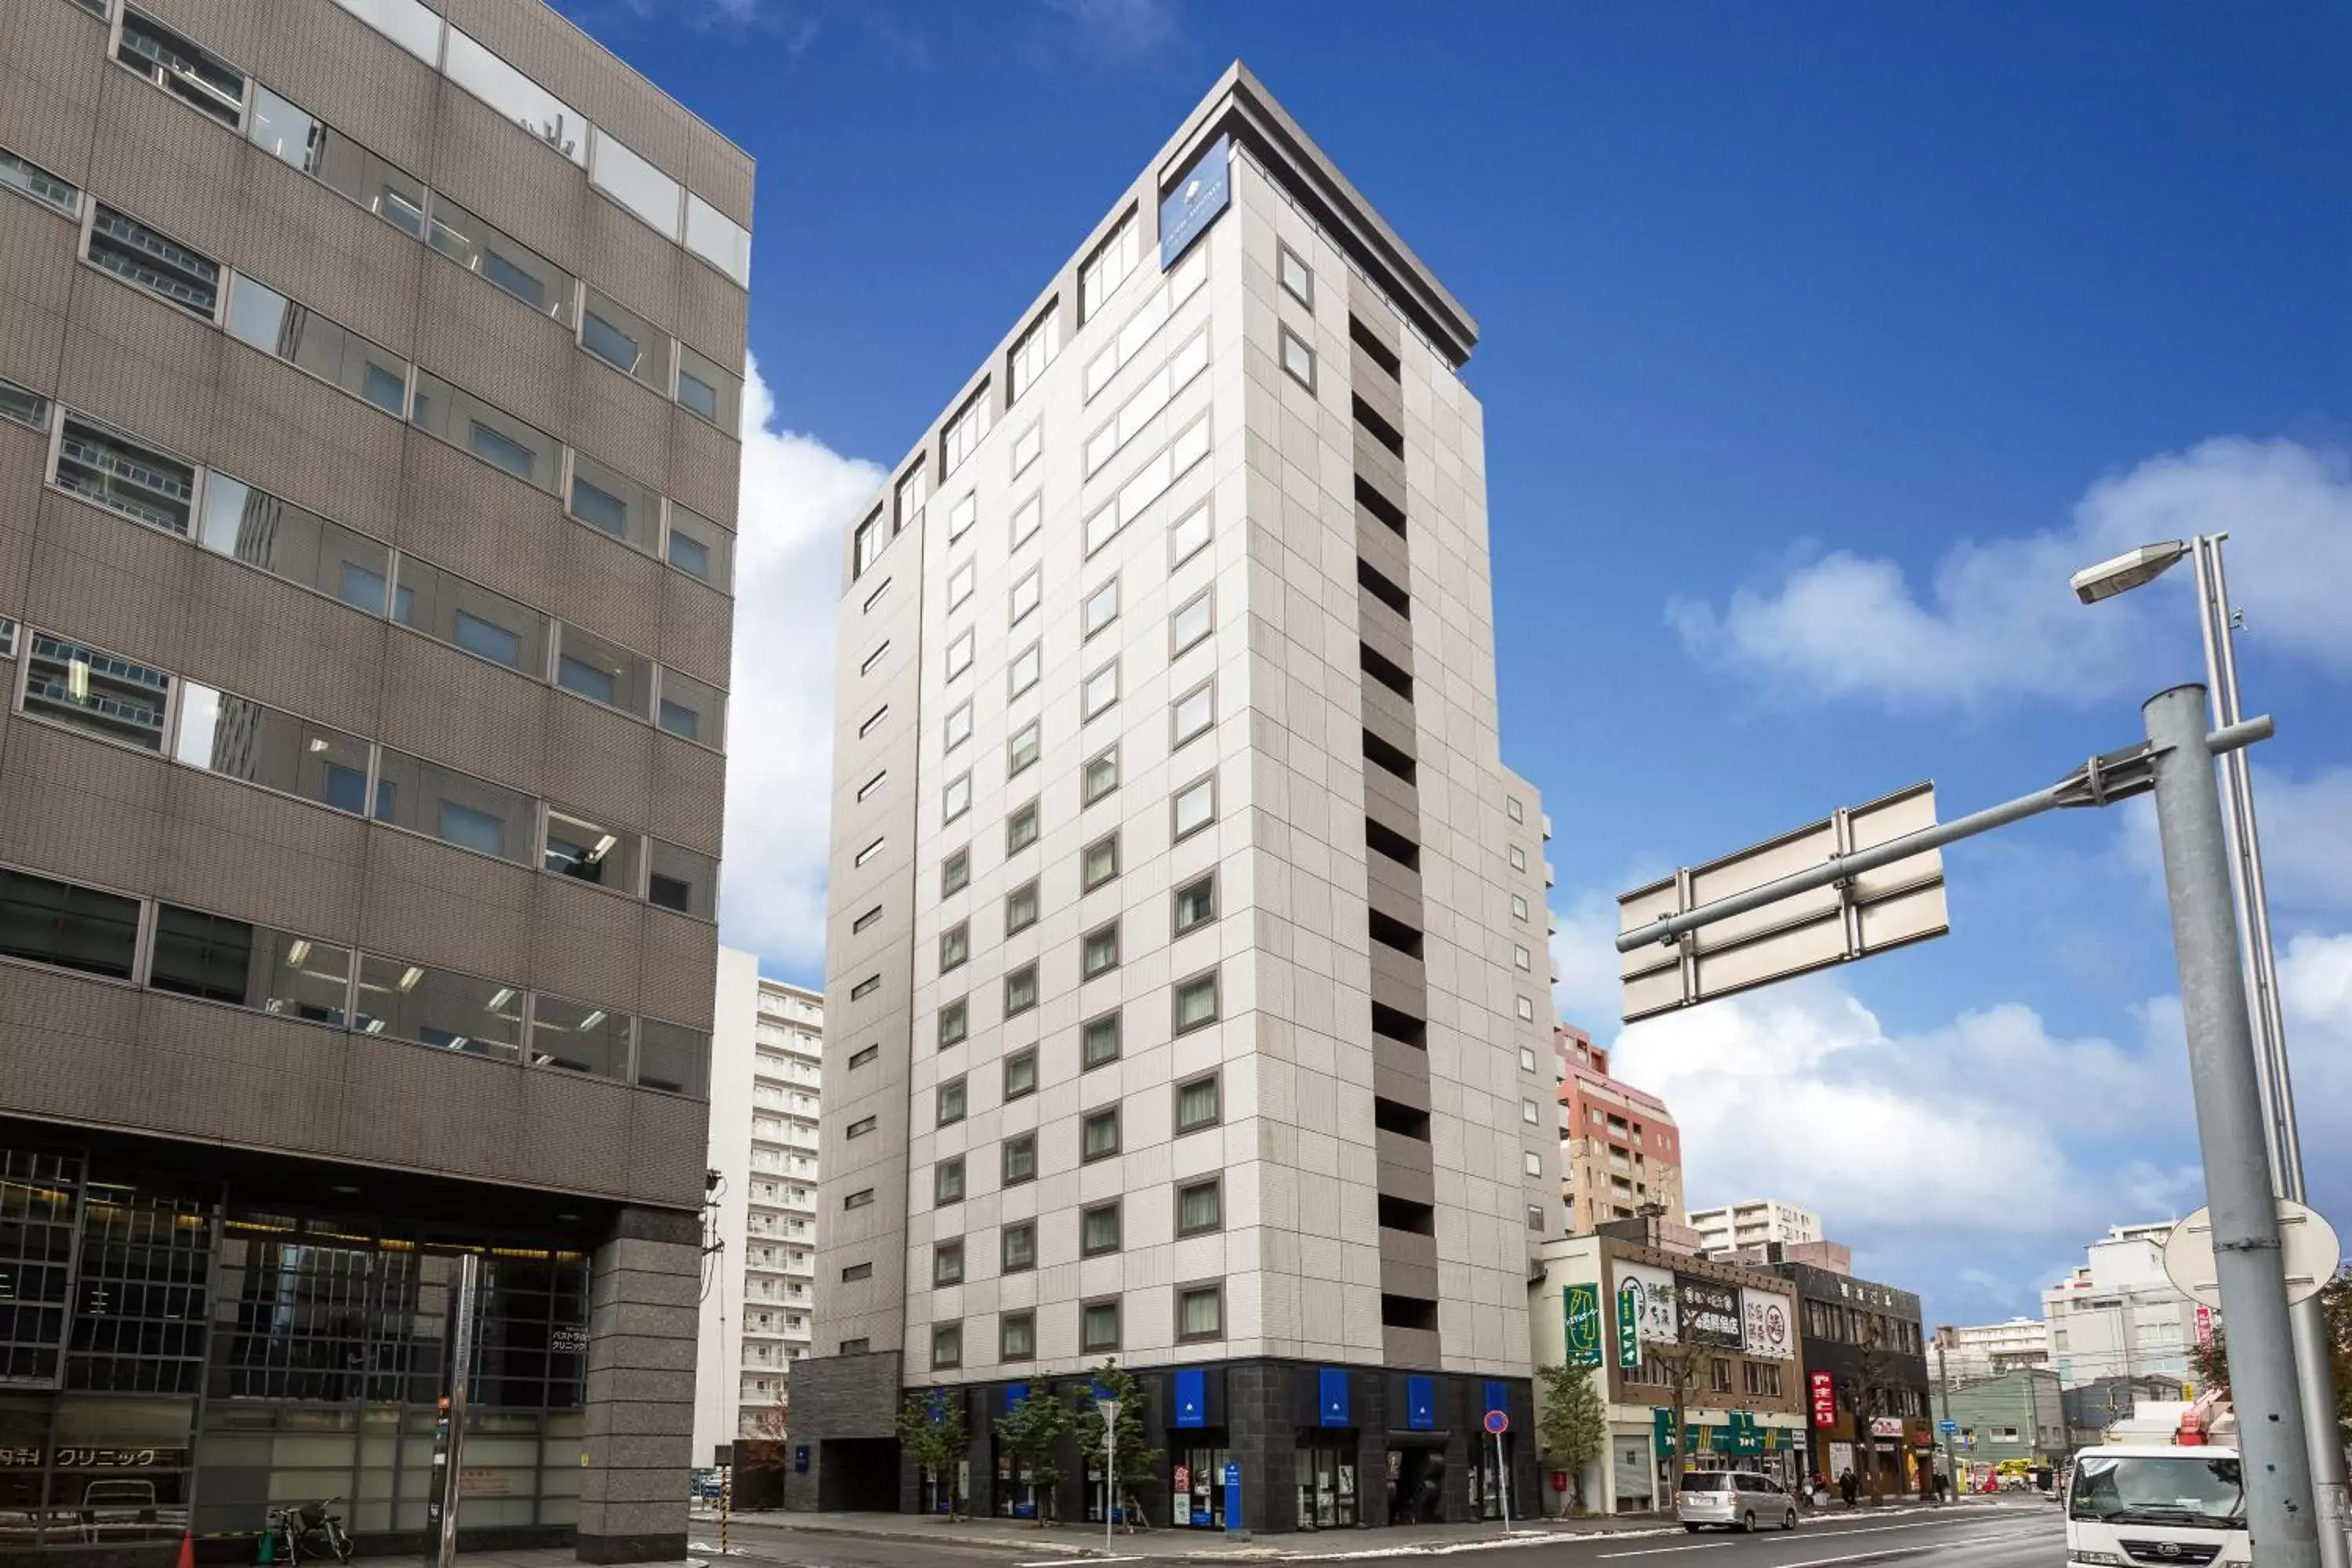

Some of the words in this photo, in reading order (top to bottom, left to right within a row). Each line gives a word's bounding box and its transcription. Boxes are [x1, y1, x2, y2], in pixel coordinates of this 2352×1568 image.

[57, 1450, 154, 1465] クリニック
